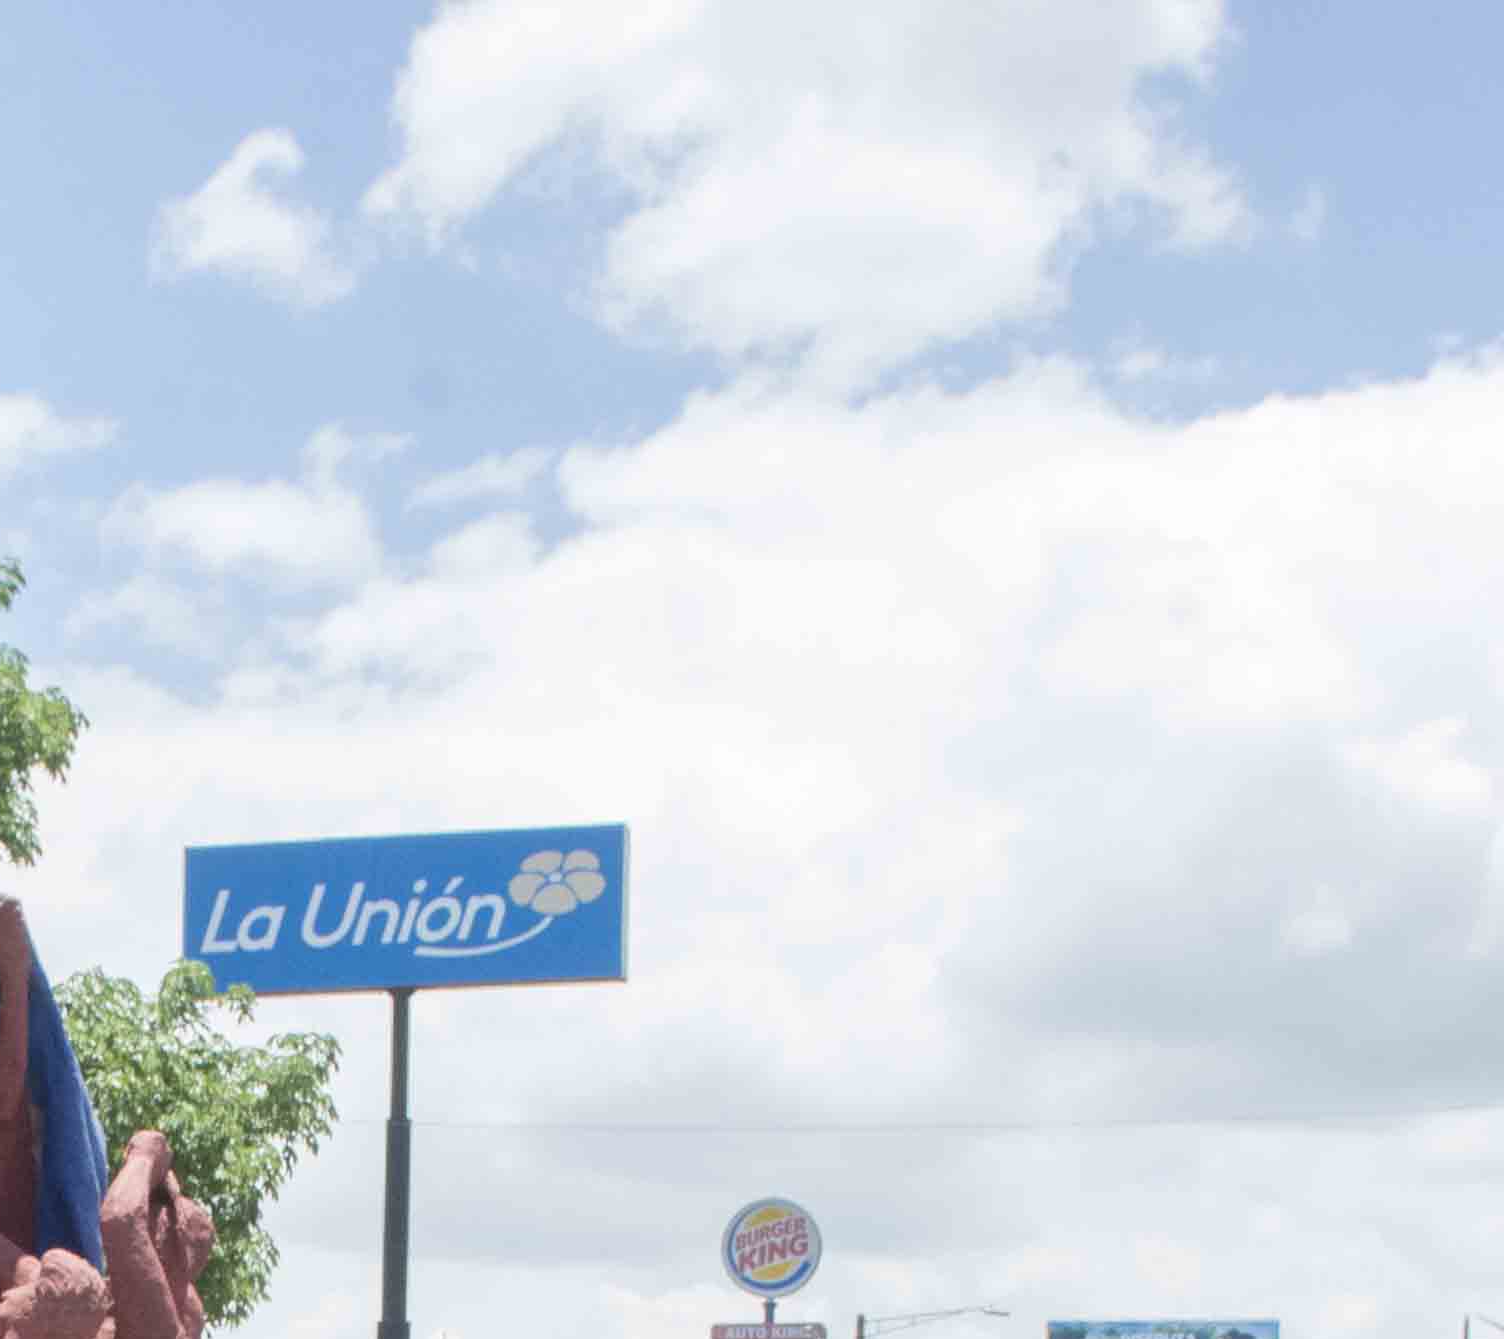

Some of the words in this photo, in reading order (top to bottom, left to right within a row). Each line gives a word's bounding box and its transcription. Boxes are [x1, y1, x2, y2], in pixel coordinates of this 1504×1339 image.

[200, 889, 286, 954] La
[300, 876, 507, 949] Unión
[735, 1217, 808, 1250] BURGER
[736, 1234, 809, 1273] KING
